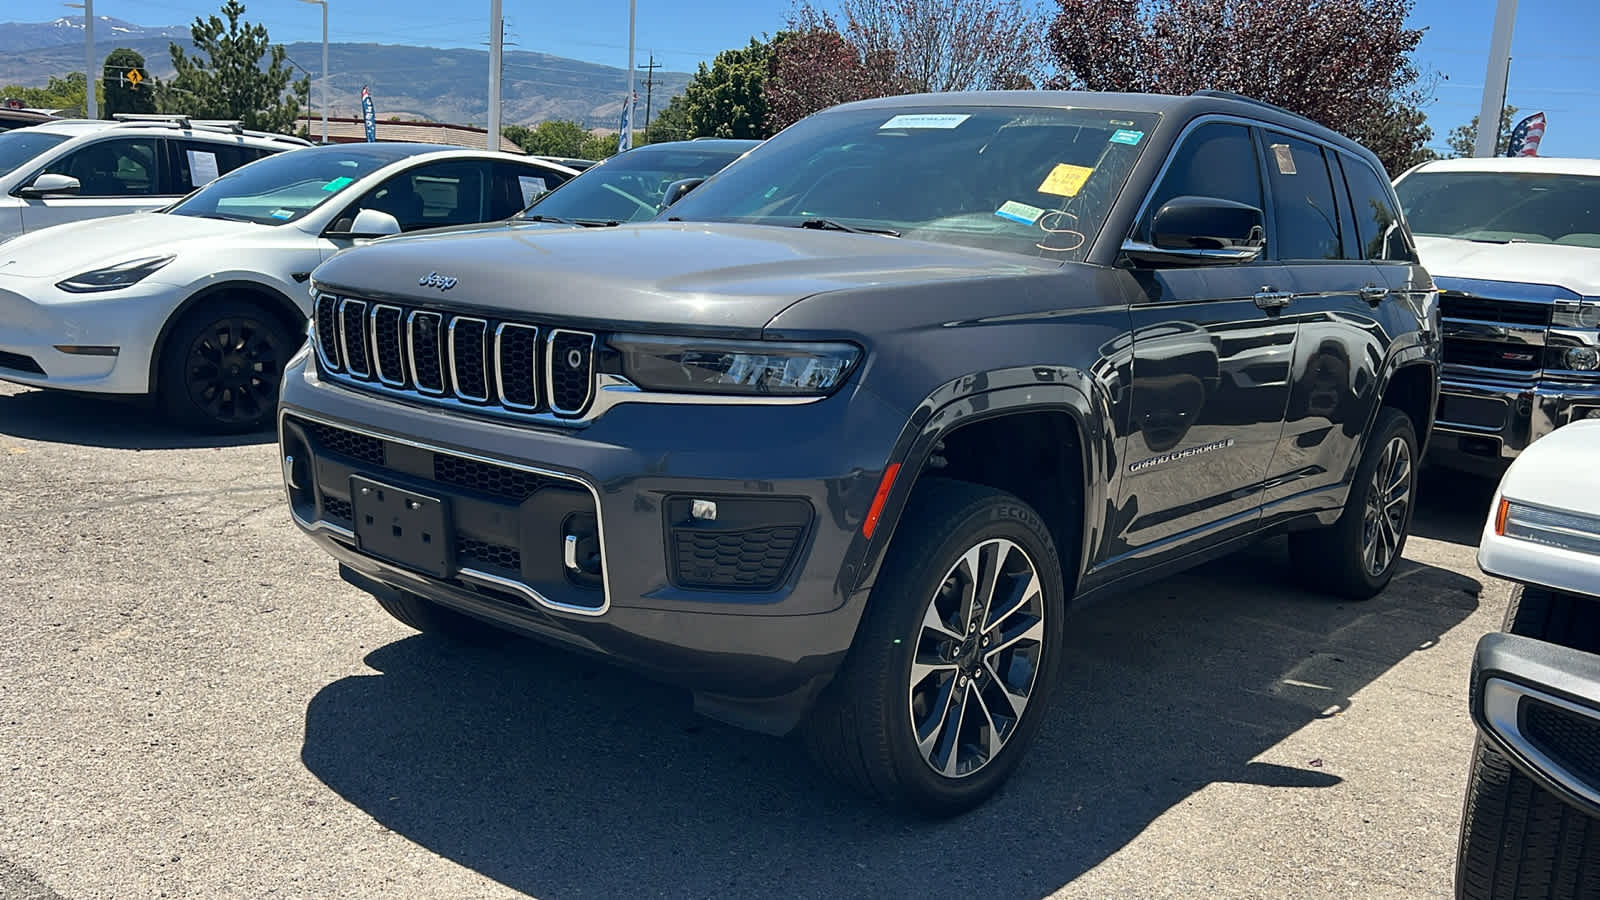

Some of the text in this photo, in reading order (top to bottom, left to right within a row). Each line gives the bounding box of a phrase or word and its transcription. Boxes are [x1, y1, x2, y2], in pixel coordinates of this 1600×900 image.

[418, 271, 457, 292] Jeep
[1129, 440, 1225, 472] GRAND CHEROKEE
